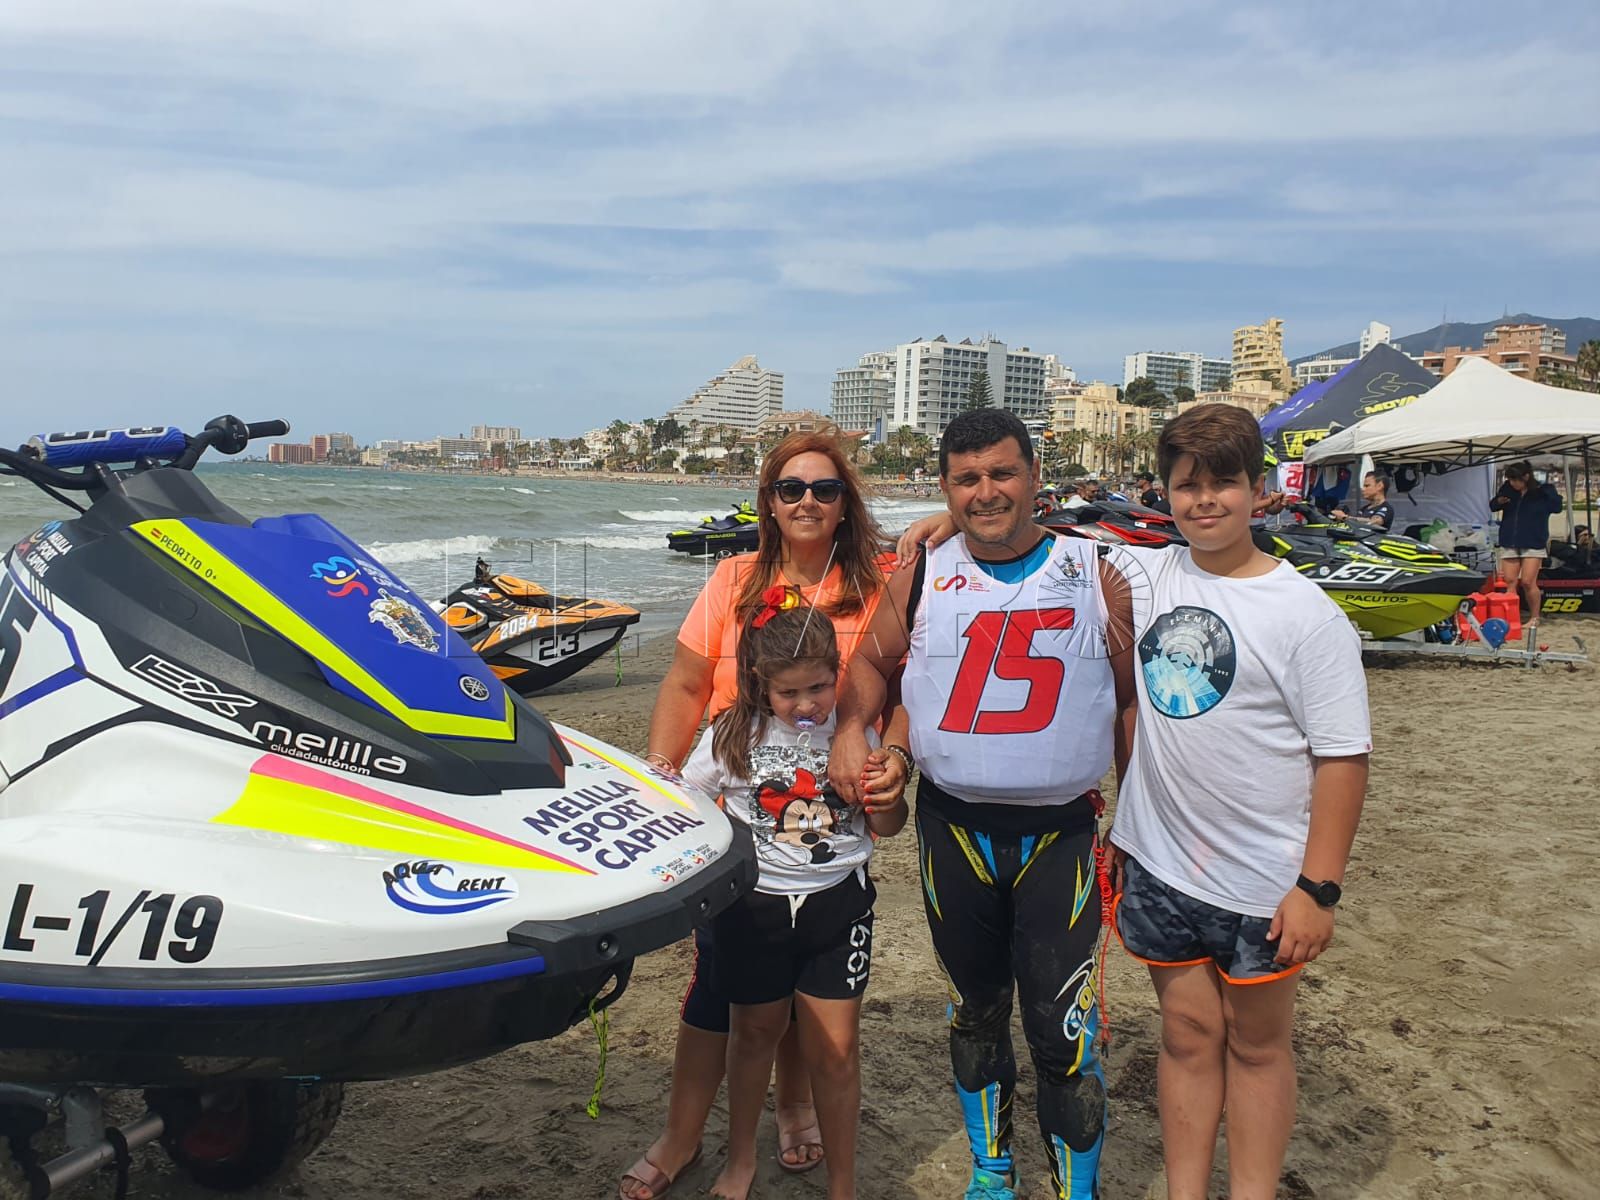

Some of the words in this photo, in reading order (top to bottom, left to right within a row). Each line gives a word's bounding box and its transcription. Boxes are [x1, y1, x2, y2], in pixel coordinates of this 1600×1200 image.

[160, 534, 202, 571] PEDRITO
[1345, 594, 1409, 603] PACUTOS
[1541, 598, 1583, 613] 58
[500, 614, 539, 641] 2094
[538, 632, 580, 661] 23
[1170, 614, 1221, 639] ELEMENT
[130, 654, 258, 718] EX
[938, 608, 1076, 734] 15
[252, 720, 407, 775] melilla
[522, 780, 640, 836] MELILLA
[557, 798, 656, 854] SPORT
[594, 811, 706, 870] CAPITAL
[456, 876, 507, 893] RENT
[2, 882, 225, 967] L-1/19
